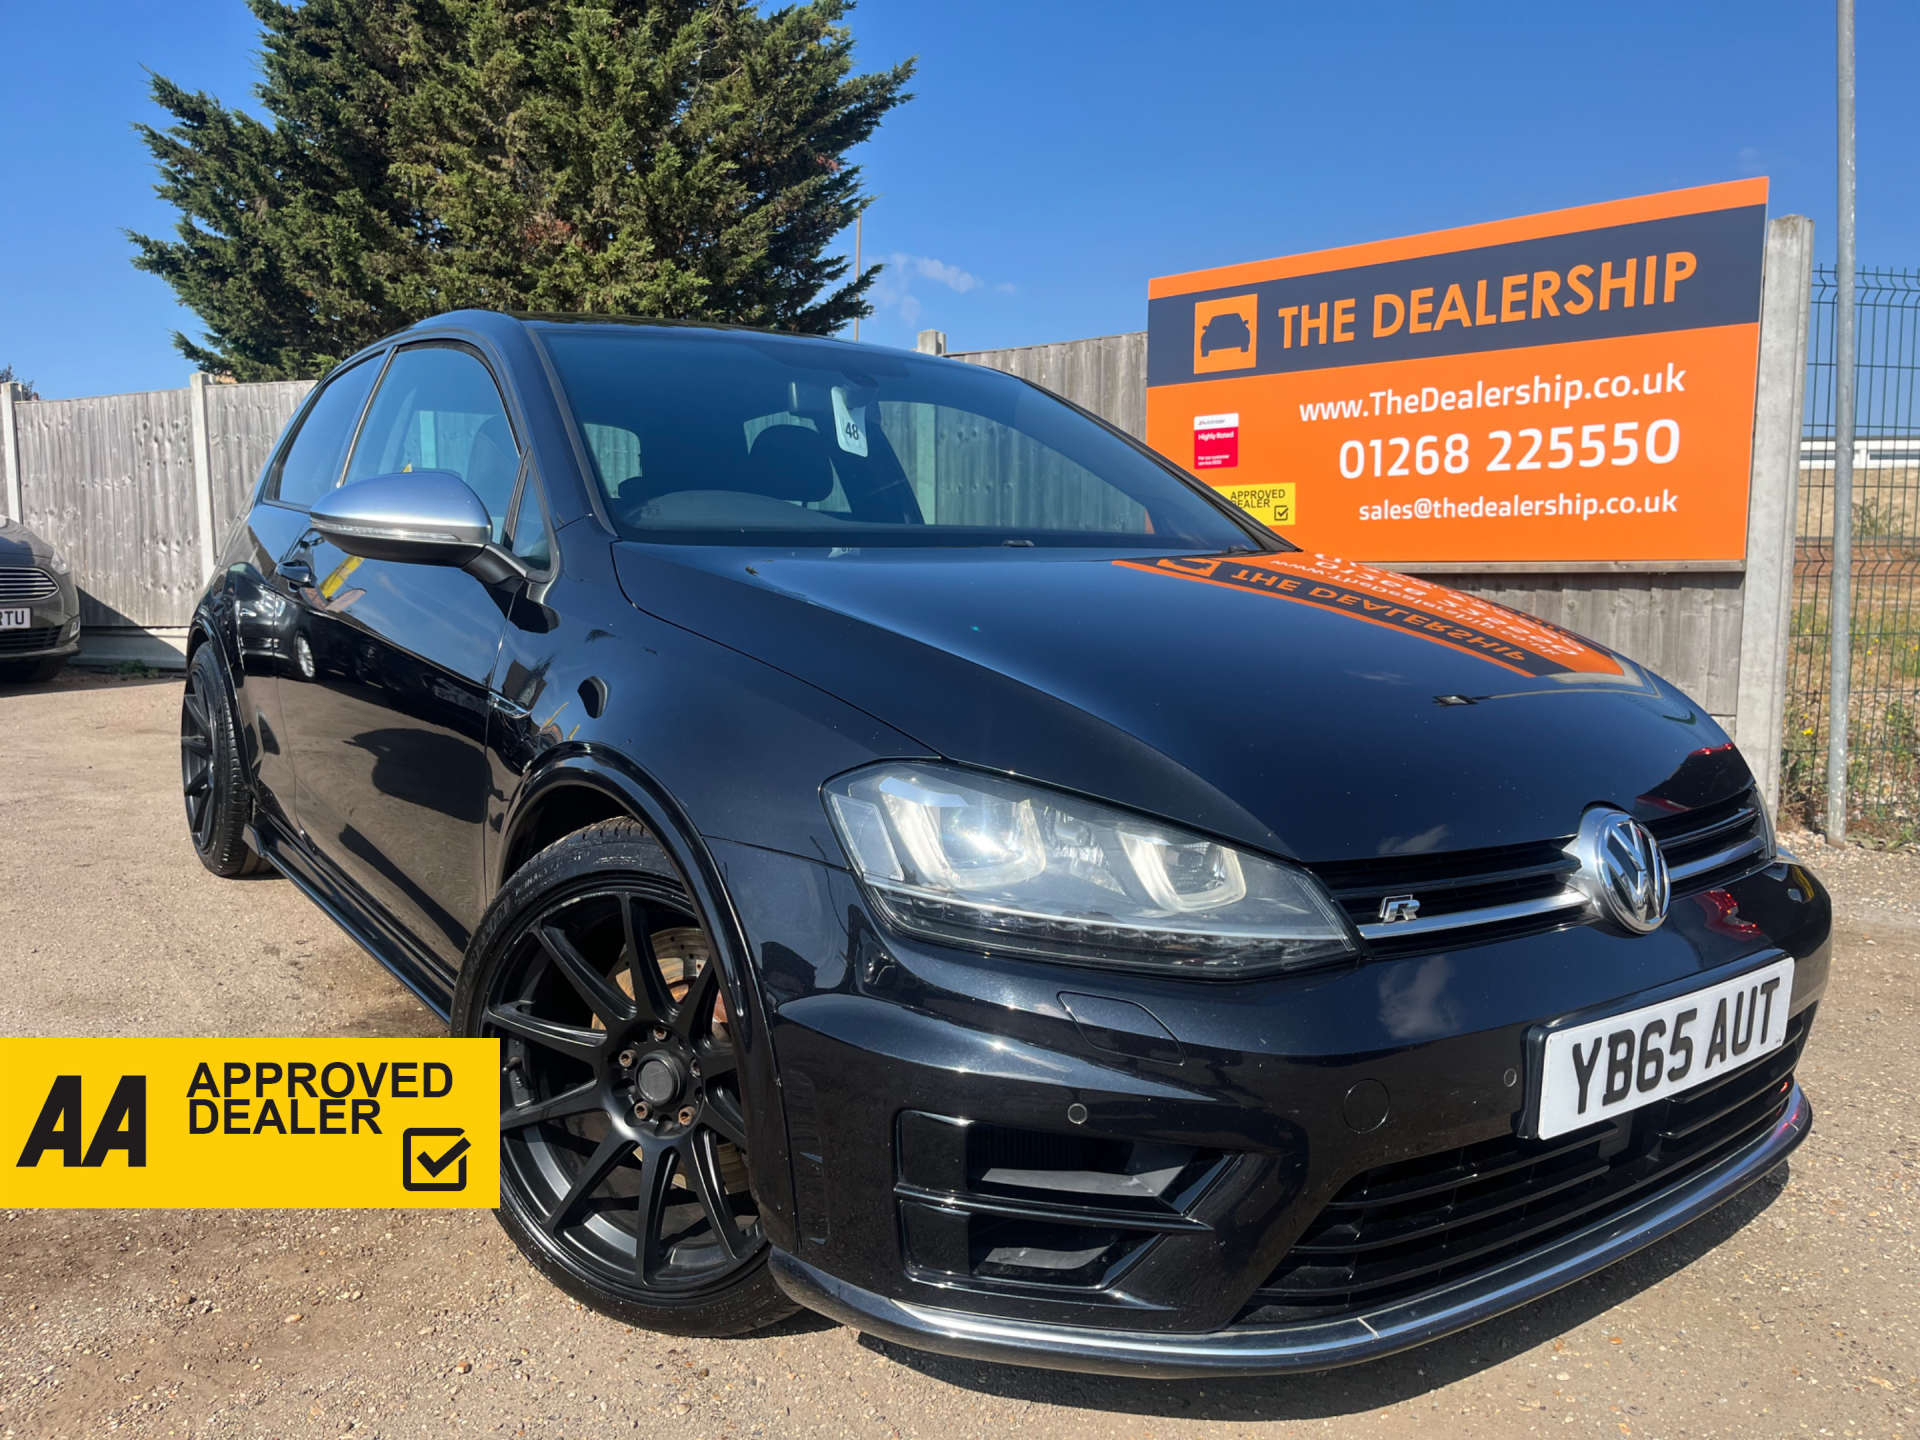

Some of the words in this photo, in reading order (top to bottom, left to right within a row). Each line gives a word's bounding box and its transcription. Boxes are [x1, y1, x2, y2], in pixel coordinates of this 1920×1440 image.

[1278, 298, 1356, 348] THE
[1373, 251, 1697, 339] DEALERSHIP
[1299, 363, 1687, 422] www.TheDealership.co.uk
[845, 422, 859, 440] 48
[1339, 433, 1470, 479] 01268
[1486, 419, 1681, 472] 225550
[1230, 488, 1286, 500] APPROVED
[1359, 489, 1679, 520] sales@thedealership.co.uk
[1572, 1008, 1697, 1115] YB65
[1705, 977, 1780, 1069] AUT
